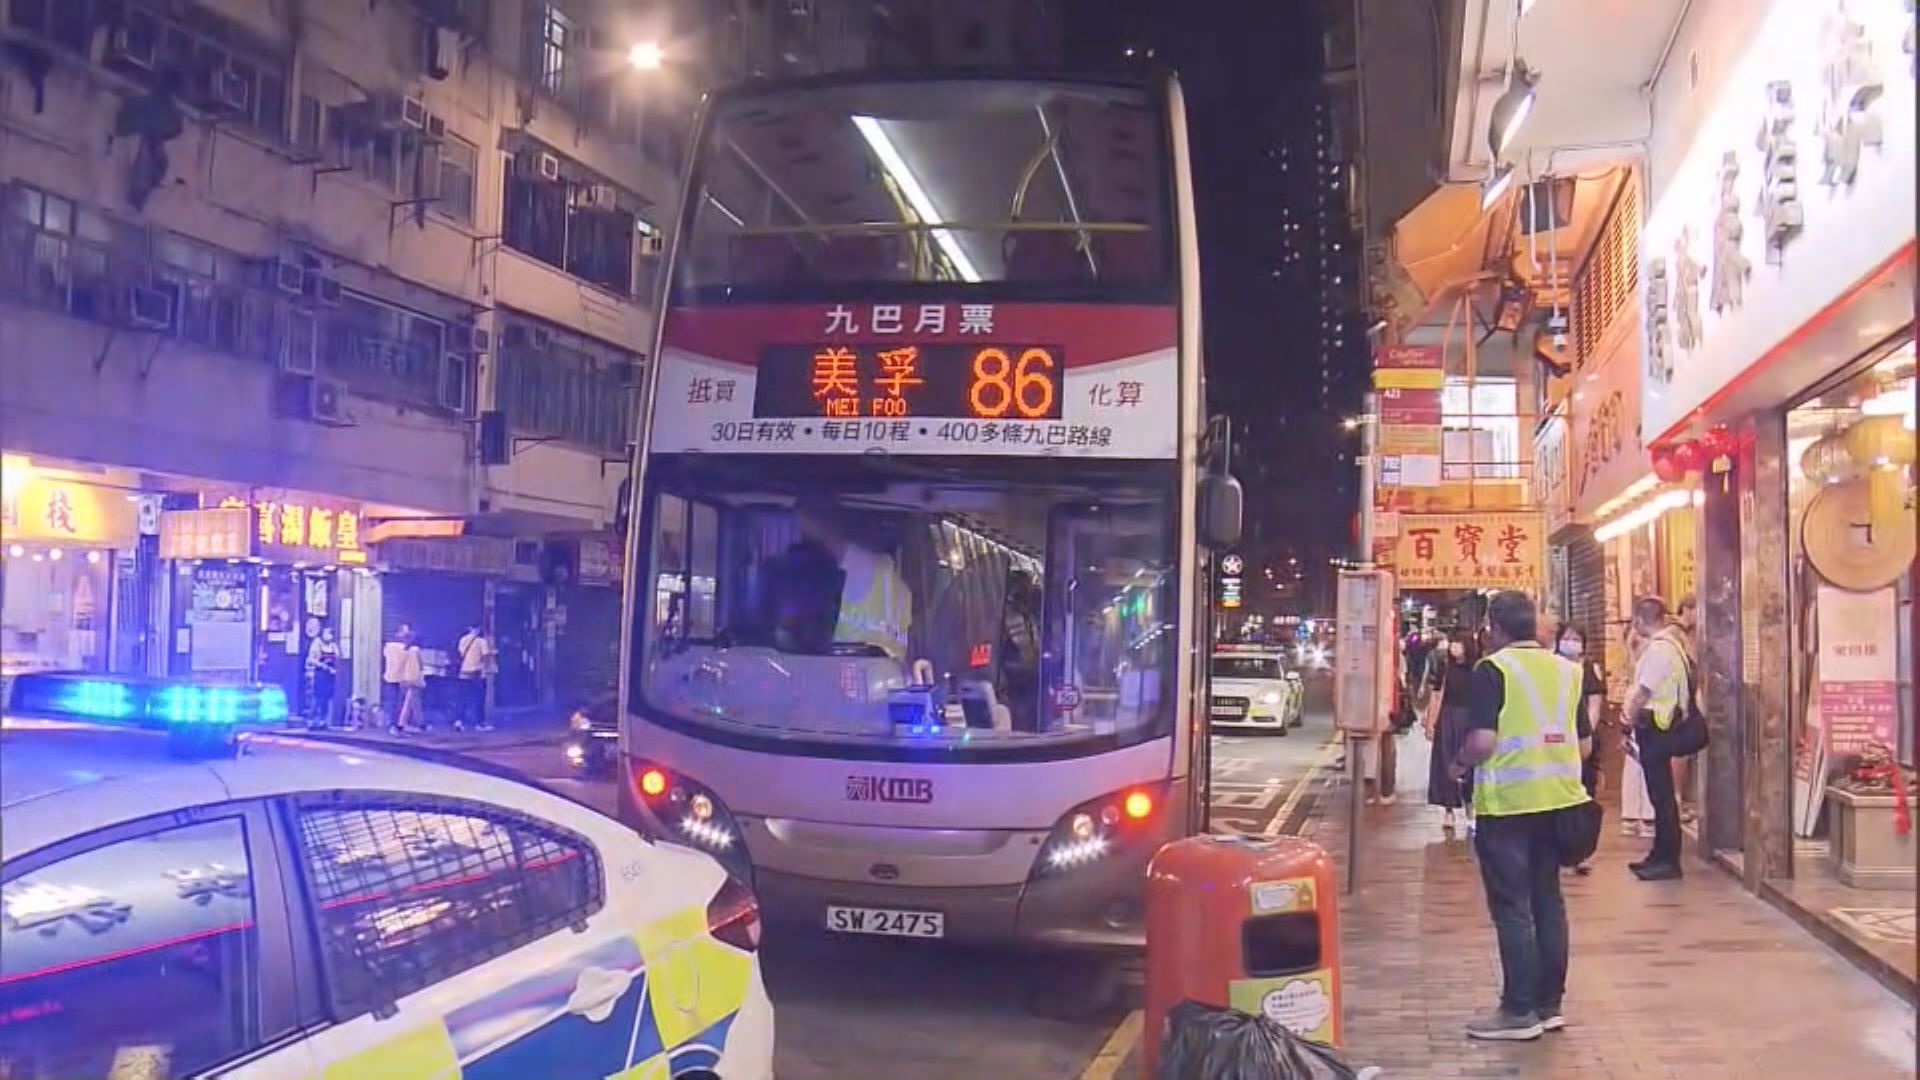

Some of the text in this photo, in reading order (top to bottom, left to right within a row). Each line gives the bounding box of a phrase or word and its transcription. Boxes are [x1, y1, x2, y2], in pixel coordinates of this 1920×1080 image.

[825, 304, 994, 334] 九巴月票
[813, 346, 924, 397] 美孚
[971, 348, 1054, 418] 86
[1088, 380, 1144, 407] 化算
[827, 399, 907, 417] MEI FOO
[711, 420, 1112, 447] 30日有效 每日10程 400多條九巴路線
[1408, 523, 1528, 564] 百寶堂
[871, 776, 934, 803] KMB
[835, 911, 938, 936] SW 2475
